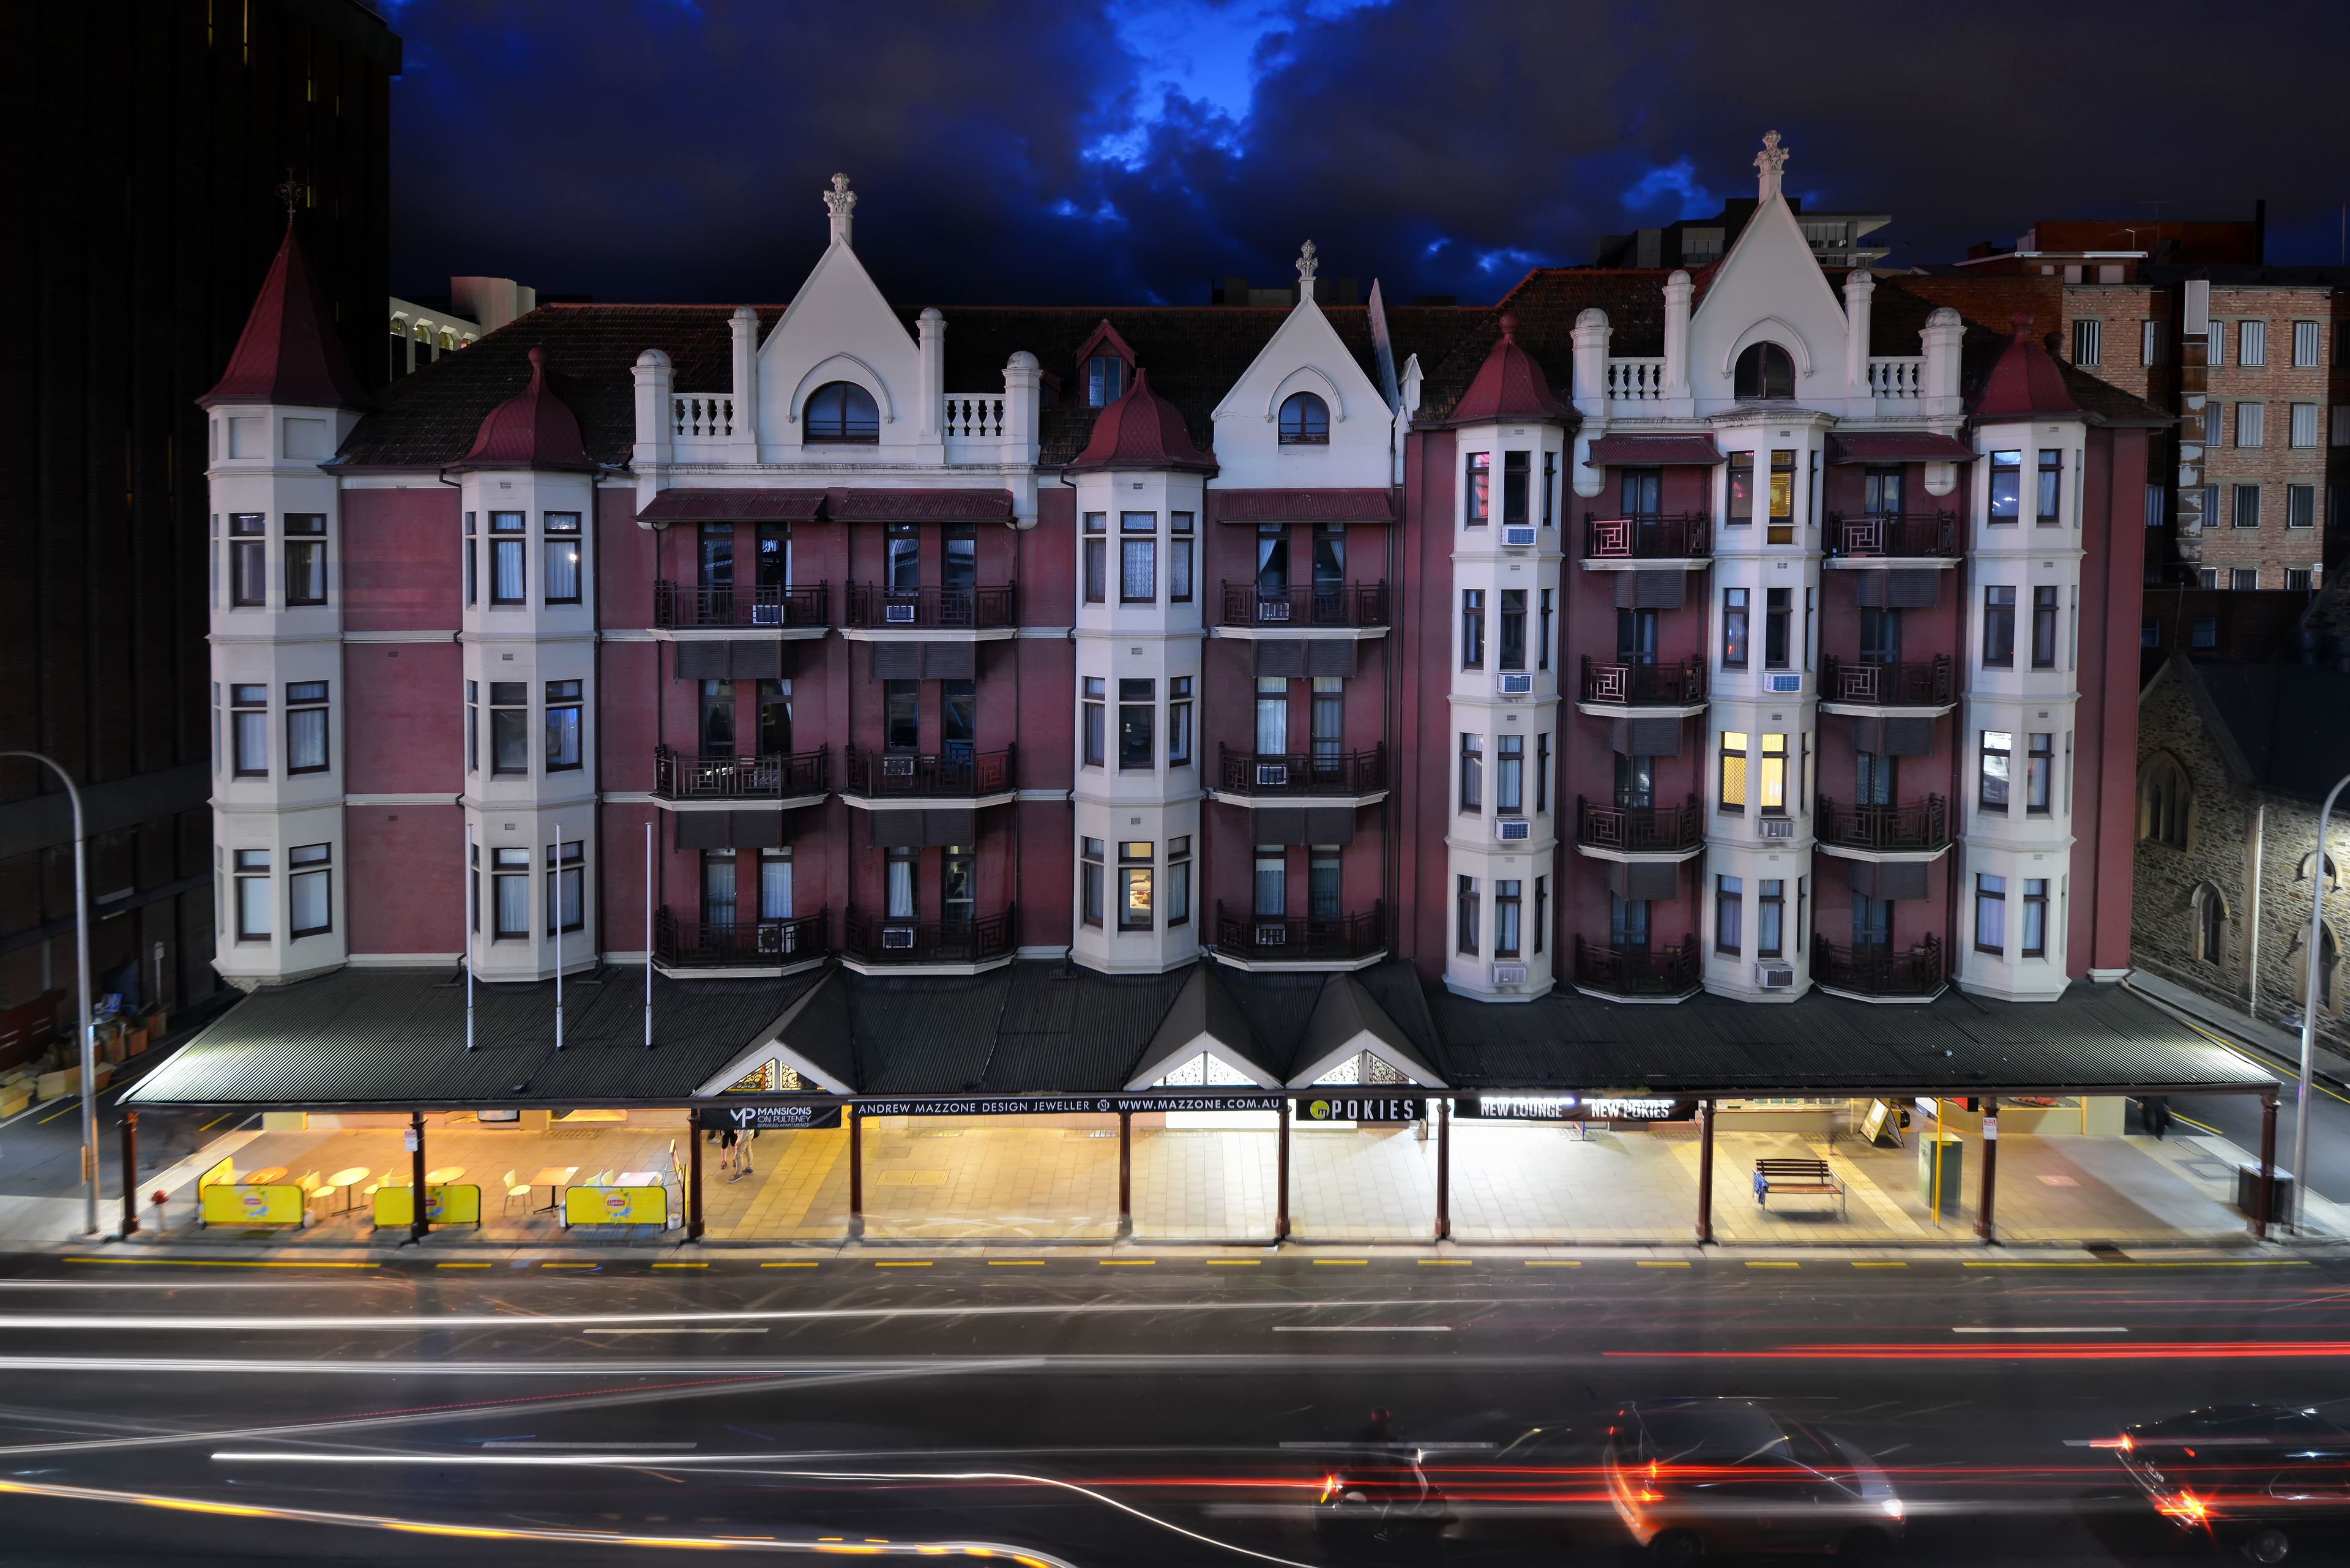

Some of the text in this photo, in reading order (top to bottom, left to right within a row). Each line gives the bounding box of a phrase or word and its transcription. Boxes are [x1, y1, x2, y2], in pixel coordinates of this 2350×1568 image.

[757, 1107, 811, 1116] MANSIONS
[858, 1101, 1089, 1114] ANDREW MAZZONE DESIGN JEWELLER
[1118, 1099, 1280, 1110] WWW.MAZZONE.COM.AU
[1332, 1100, 1414, 1120] POKIES
[1480, 1100, 1562, 1118] NEW LOUNGE
[1591, 1101, 1669, 1119] NEW POKIES
